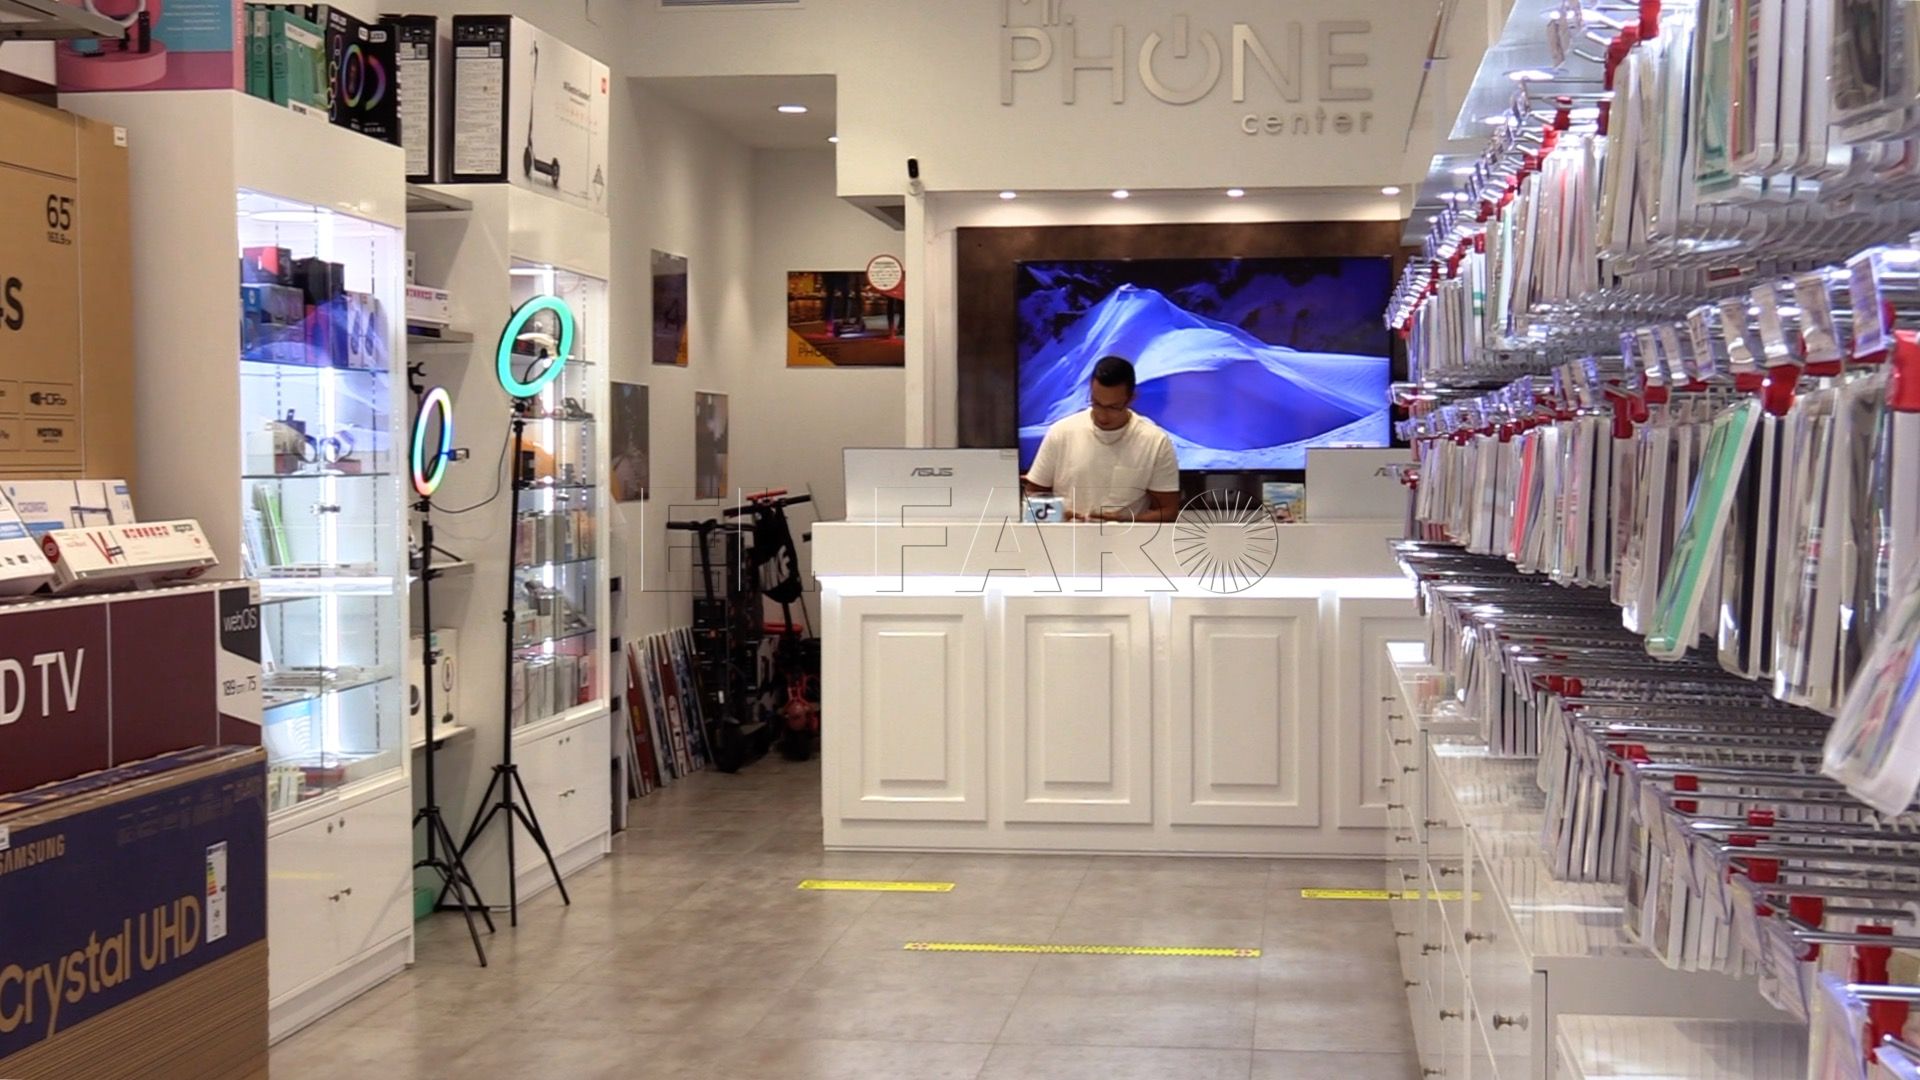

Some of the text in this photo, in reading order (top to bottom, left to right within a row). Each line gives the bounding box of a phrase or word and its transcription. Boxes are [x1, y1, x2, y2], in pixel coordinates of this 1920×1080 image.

[1000, 15, 1373, 106] PHONE
[1241, 107, 1373, 136] center
[0, 276, 24, 331] S
[911, 467, 954, 477] ASUS
[32, 648, 85, 717] TV
[0, 895, 200, 1039] Crystal UHD
